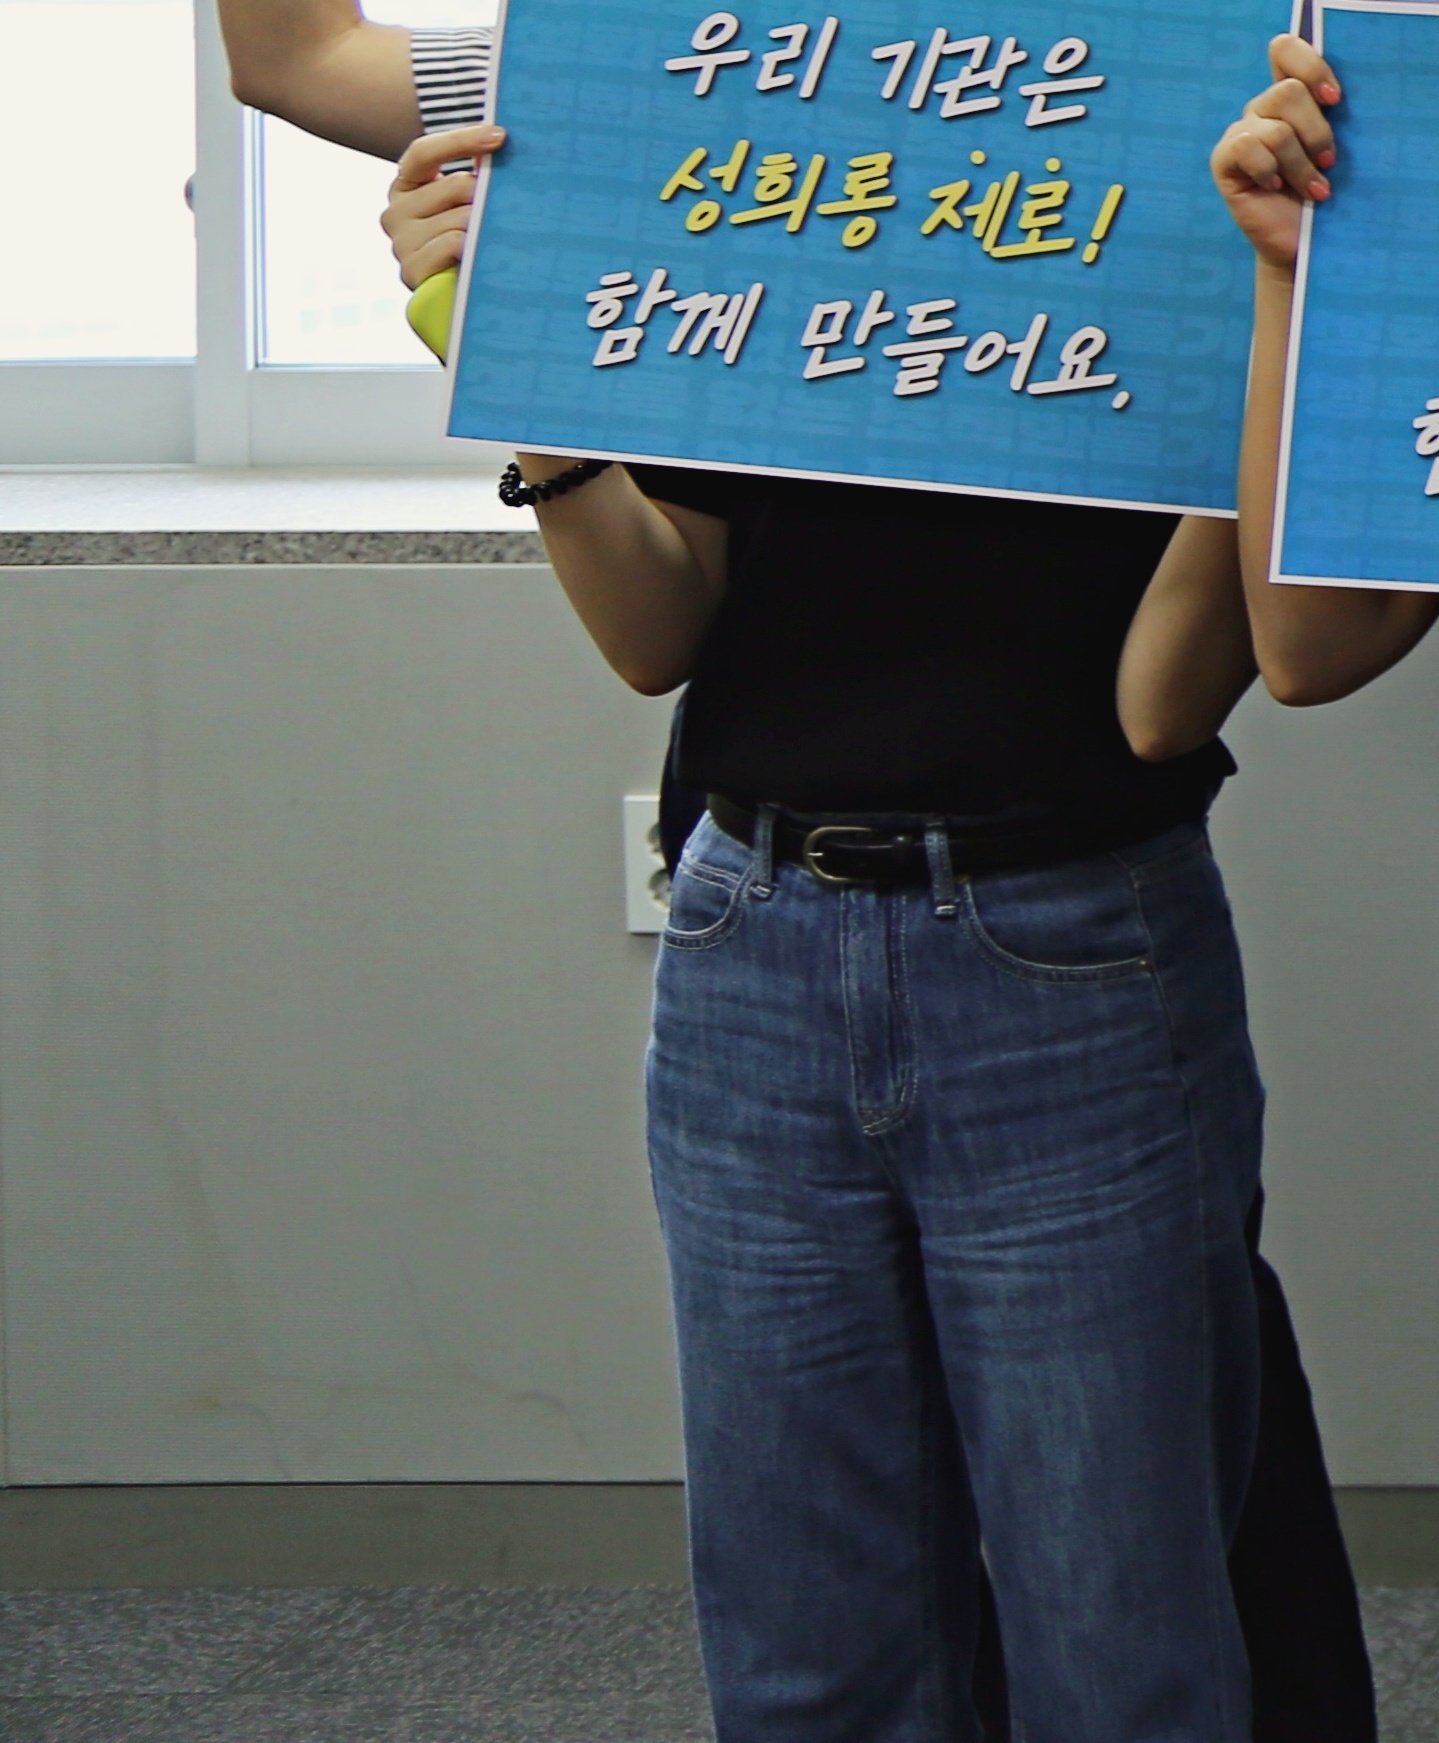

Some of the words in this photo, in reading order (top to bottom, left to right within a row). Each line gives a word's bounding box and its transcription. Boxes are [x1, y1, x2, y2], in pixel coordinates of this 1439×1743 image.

[664, 11, 839, 99] 우리
[871, 26, 1104, 128] 기관은
[658, 139, 897, 248] 성희롱
[920, 164, 1124, 264] 제로!
[585, 268, 766, 367] 함께
